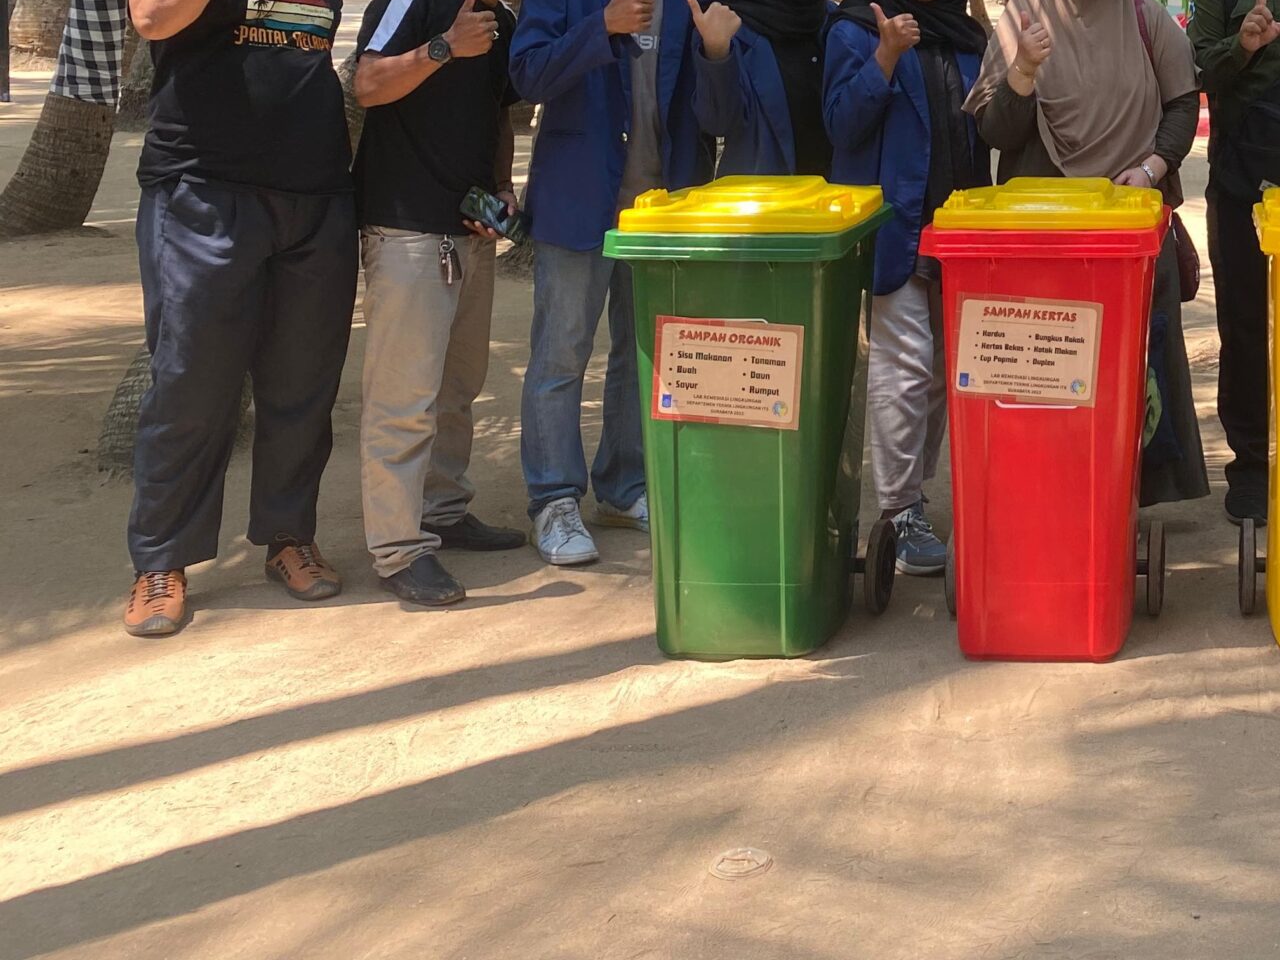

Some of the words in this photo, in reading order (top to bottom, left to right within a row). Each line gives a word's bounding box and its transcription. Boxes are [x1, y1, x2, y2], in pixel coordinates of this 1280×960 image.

[234, 25, 287, 45] PANTAI
[983, 307, 1031, 319] SAMPAH
[1033, 310, 1077, 322] KERTAS
[679, 330, 726, 342] SAMPAH
[729, 334, 781, 347] ORGANIK
[678, 351, 693, 359] Sisa
[695, 352, 732, 362] Makanan
[751, 357, 786, 366] Tanaman
[677, 366, 697, 374] Buah
[676, 381, 698, 390] Sayur
[749, 386, 779, 396] Rumput
